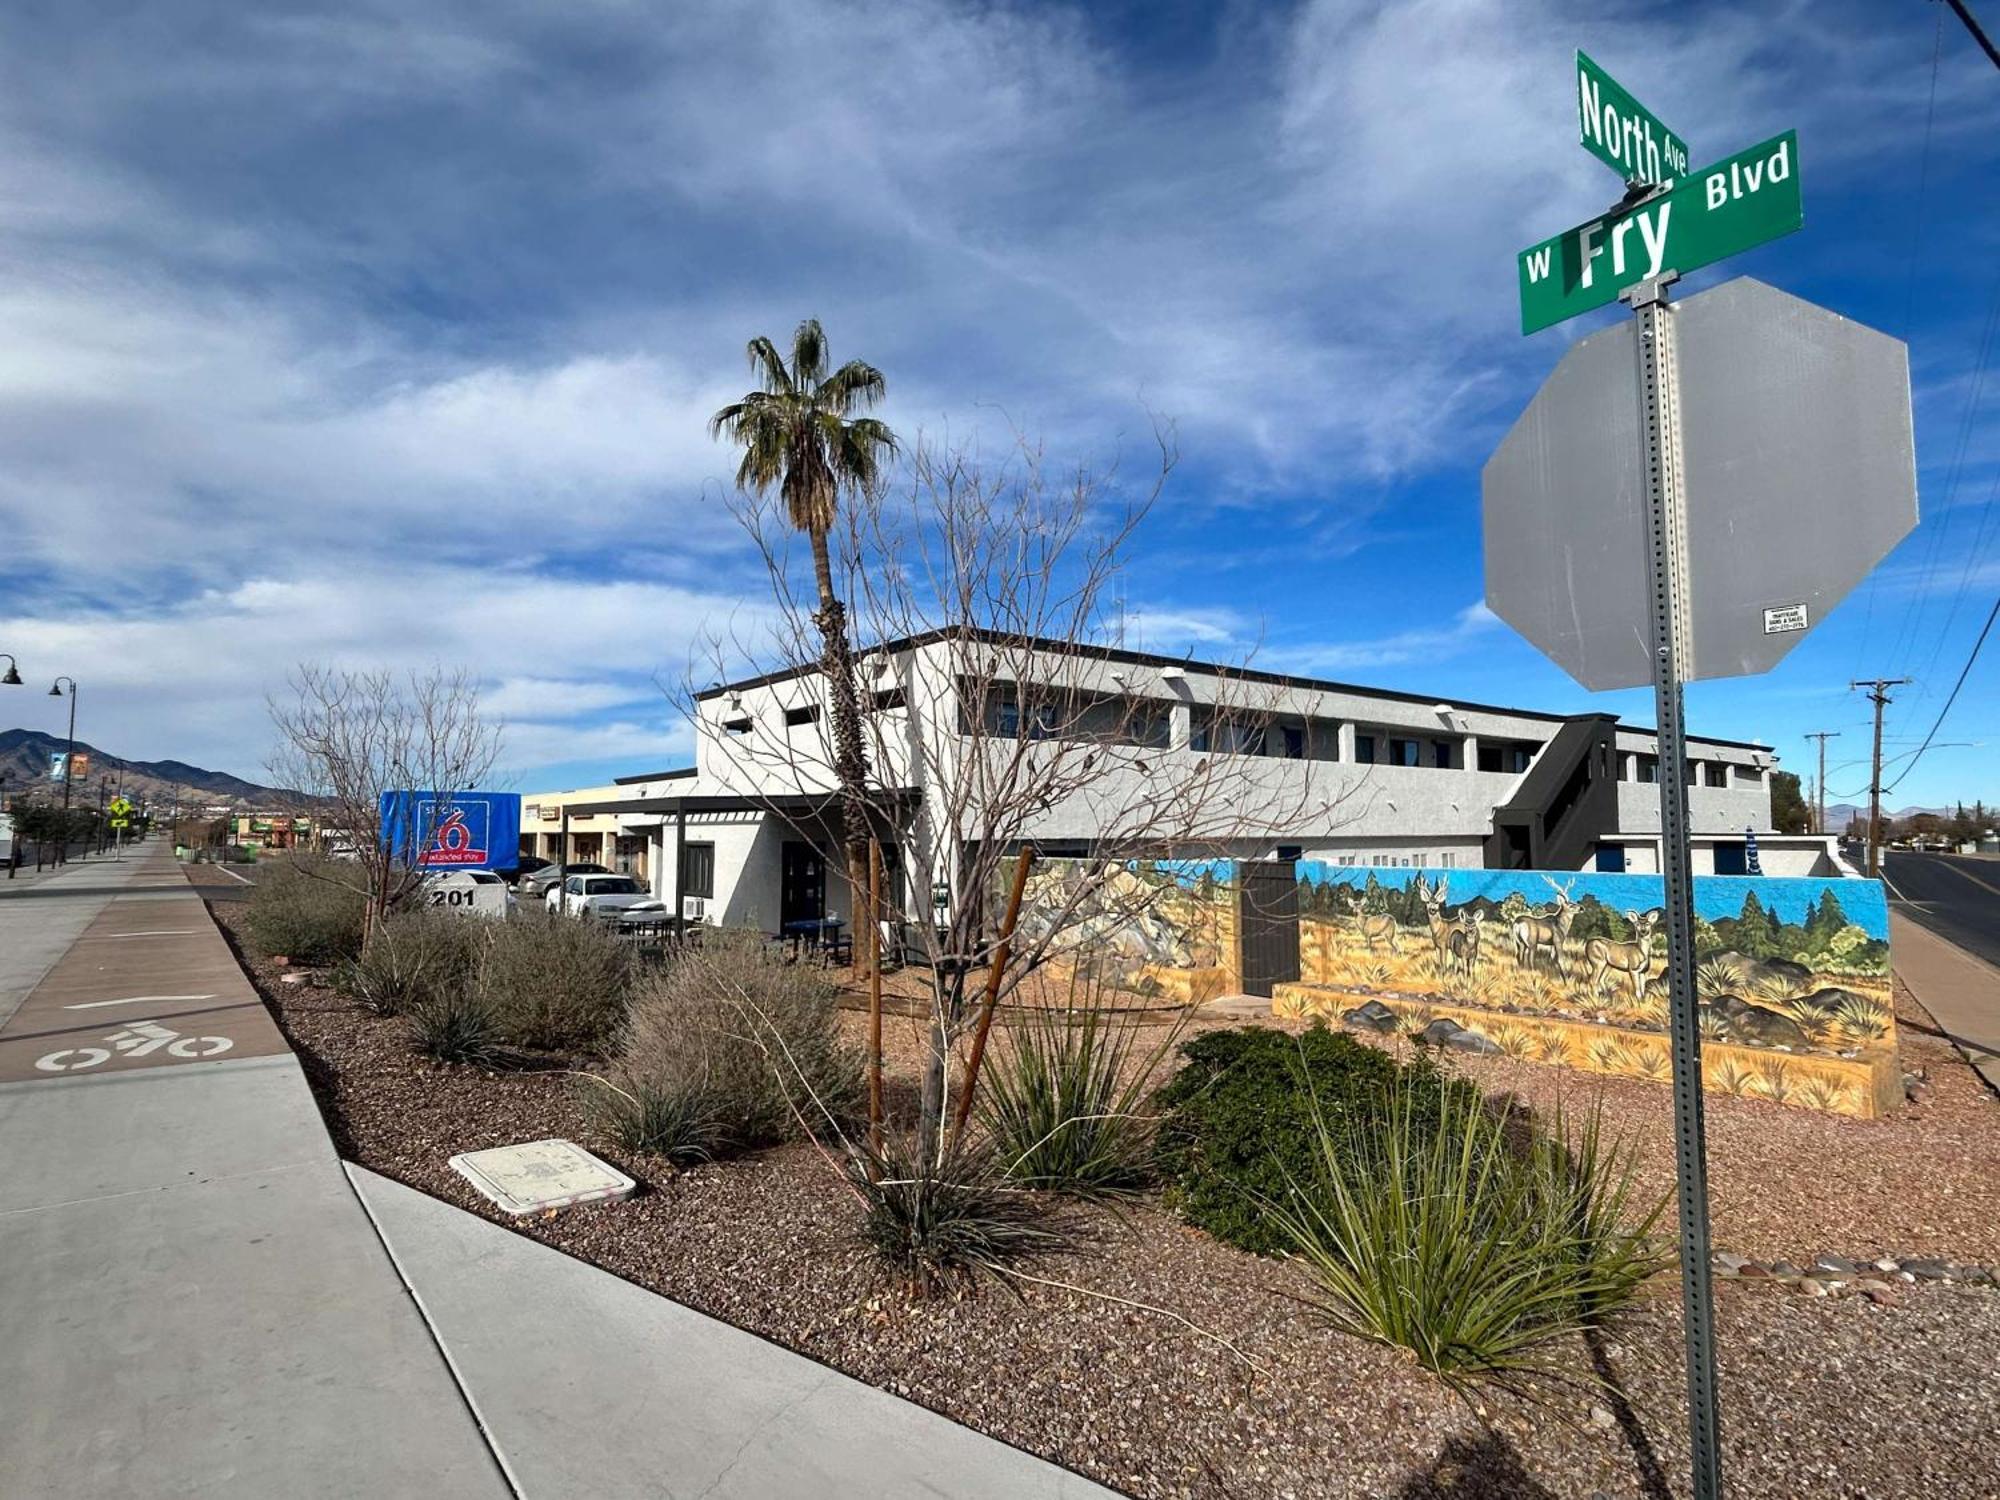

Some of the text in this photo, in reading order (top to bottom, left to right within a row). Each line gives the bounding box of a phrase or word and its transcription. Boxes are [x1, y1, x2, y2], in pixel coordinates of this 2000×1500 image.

[1580, 70, 1687, 184] North Ave
[1526, 140, 1790, 288] W Fry Blvd
[437, 811, 470, 851] 6
[432, 890, 474, 906] 201
